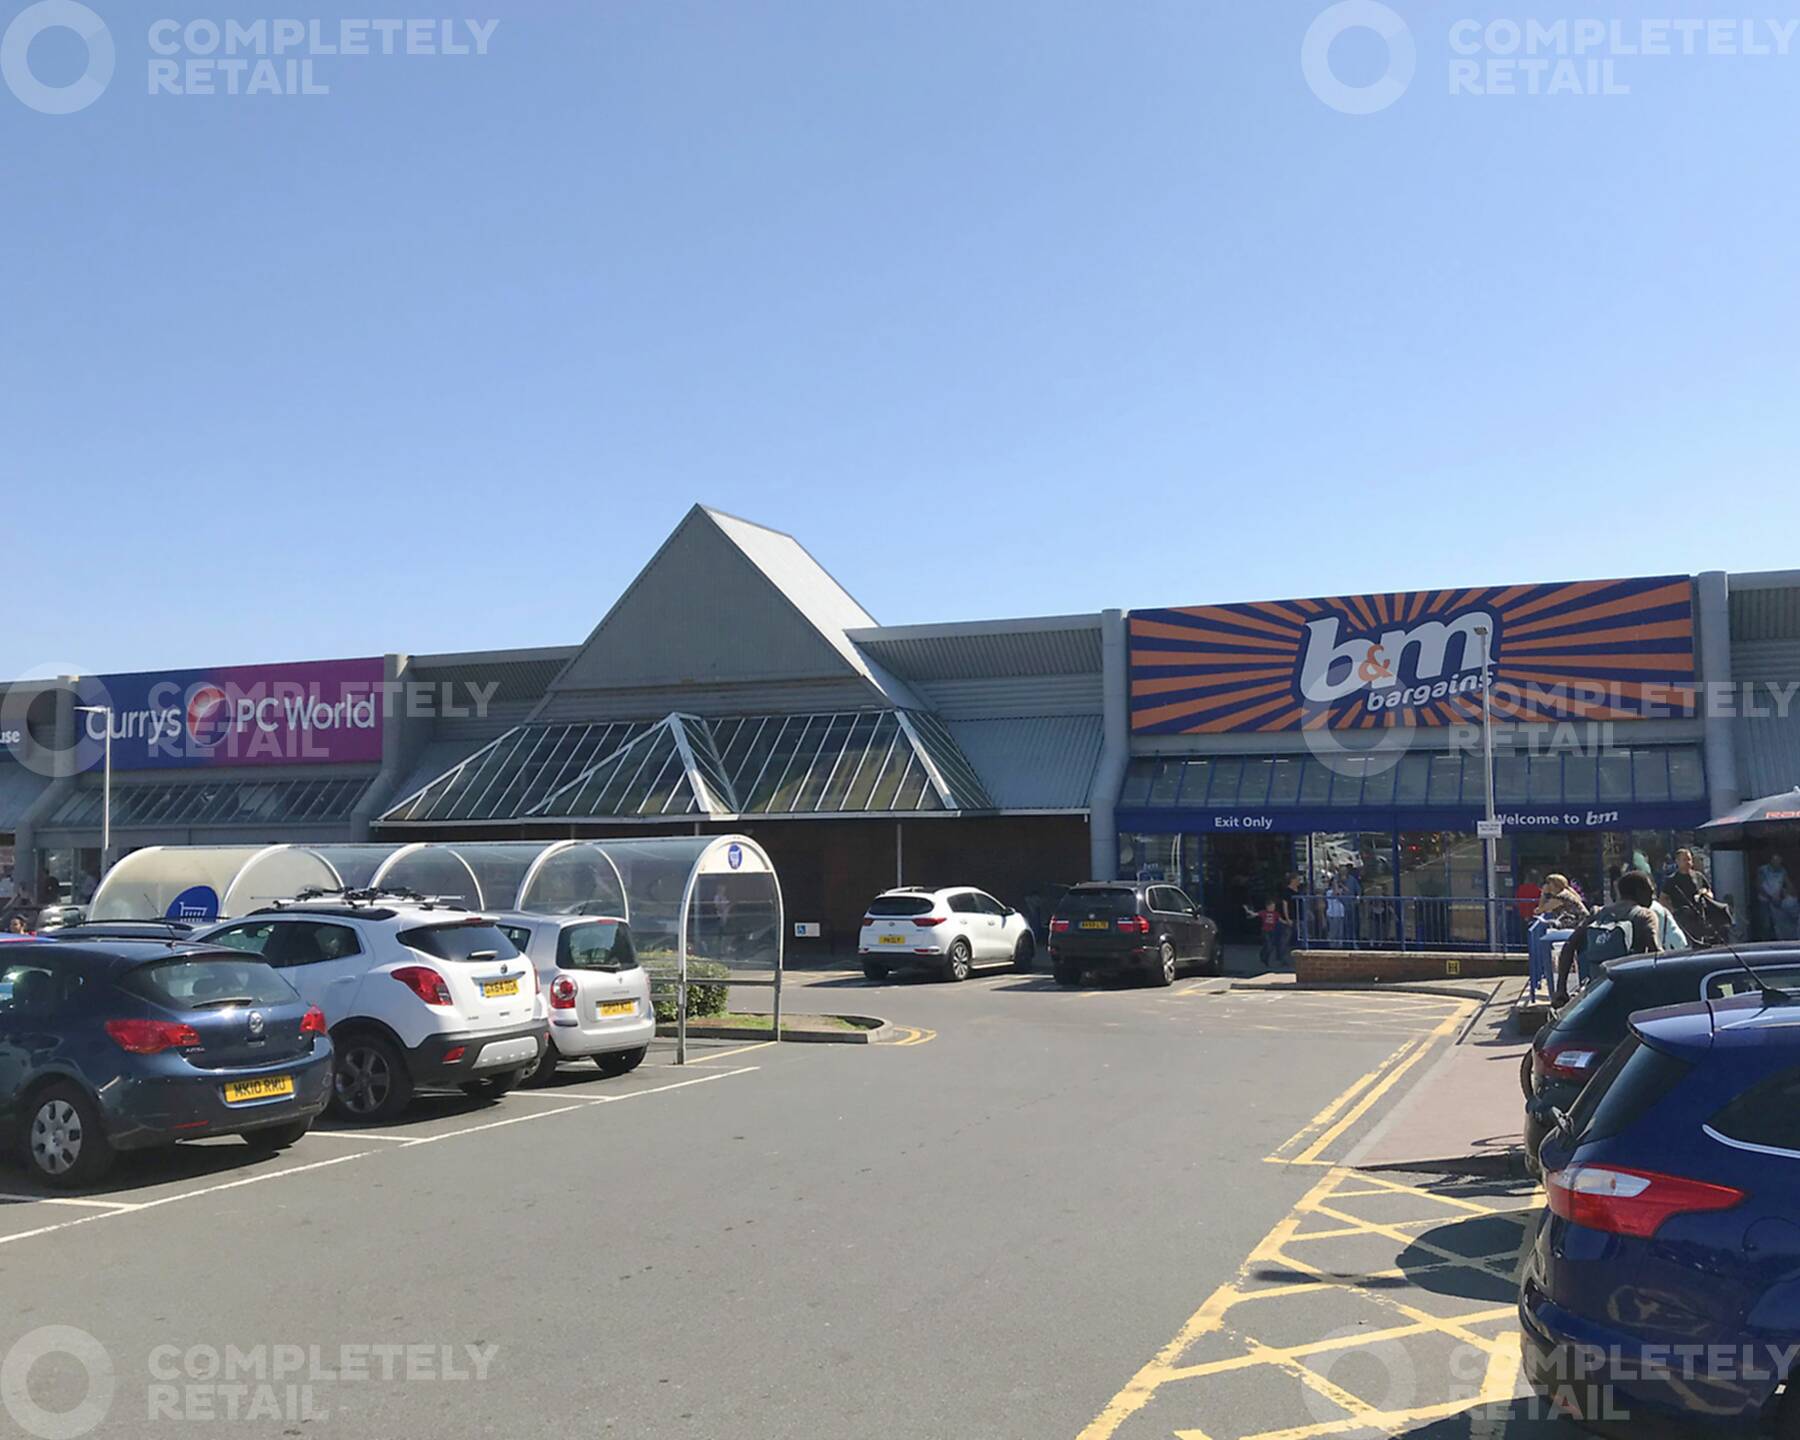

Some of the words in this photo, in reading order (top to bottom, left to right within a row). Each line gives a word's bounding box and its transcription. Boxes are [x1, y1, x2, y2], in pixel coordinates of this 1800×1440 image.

[1367, 672, 1494, 711] bargains
[86, 707, 182, 745] Currys
[237, 697, 279, 732] PC
[284, 692, 375, 730] World
[1215, 816, 1239, 828] Exit
[1243, 816, 1273, 830] Only
[1563, 813, 1580, 825] to
